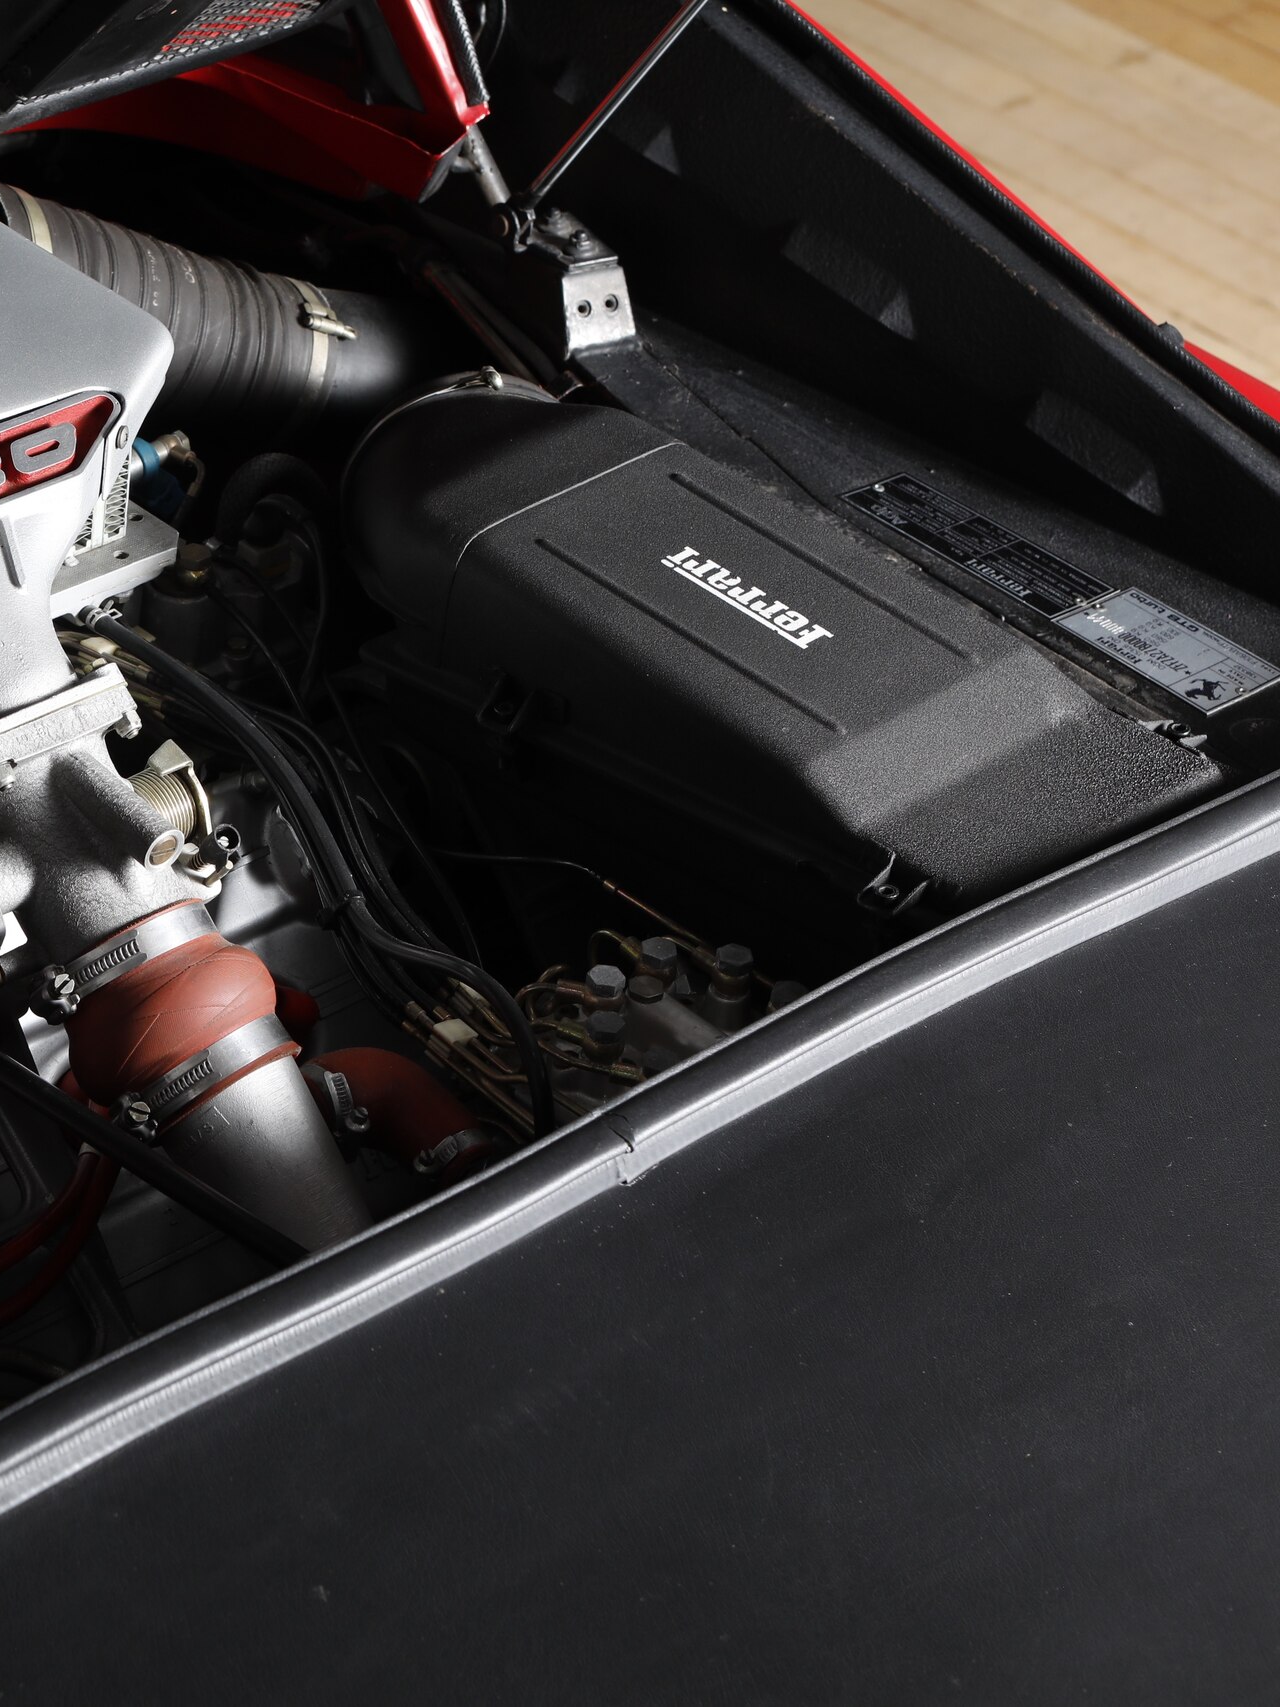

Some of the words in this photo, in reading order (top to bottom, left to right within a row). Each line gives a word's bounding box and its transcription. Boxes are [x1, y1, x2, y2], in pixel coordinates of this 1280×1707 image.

[870, 504, 909, 525] Agip
[964, 558, 1033, 598] Ferrari
[661, 546, 834, 650] Ferrari
[1130, 592, 1166, 615] turbo
[1166, 613, 1200, 633] GTB
[1096, 636, 1143, 665] Ferrari
